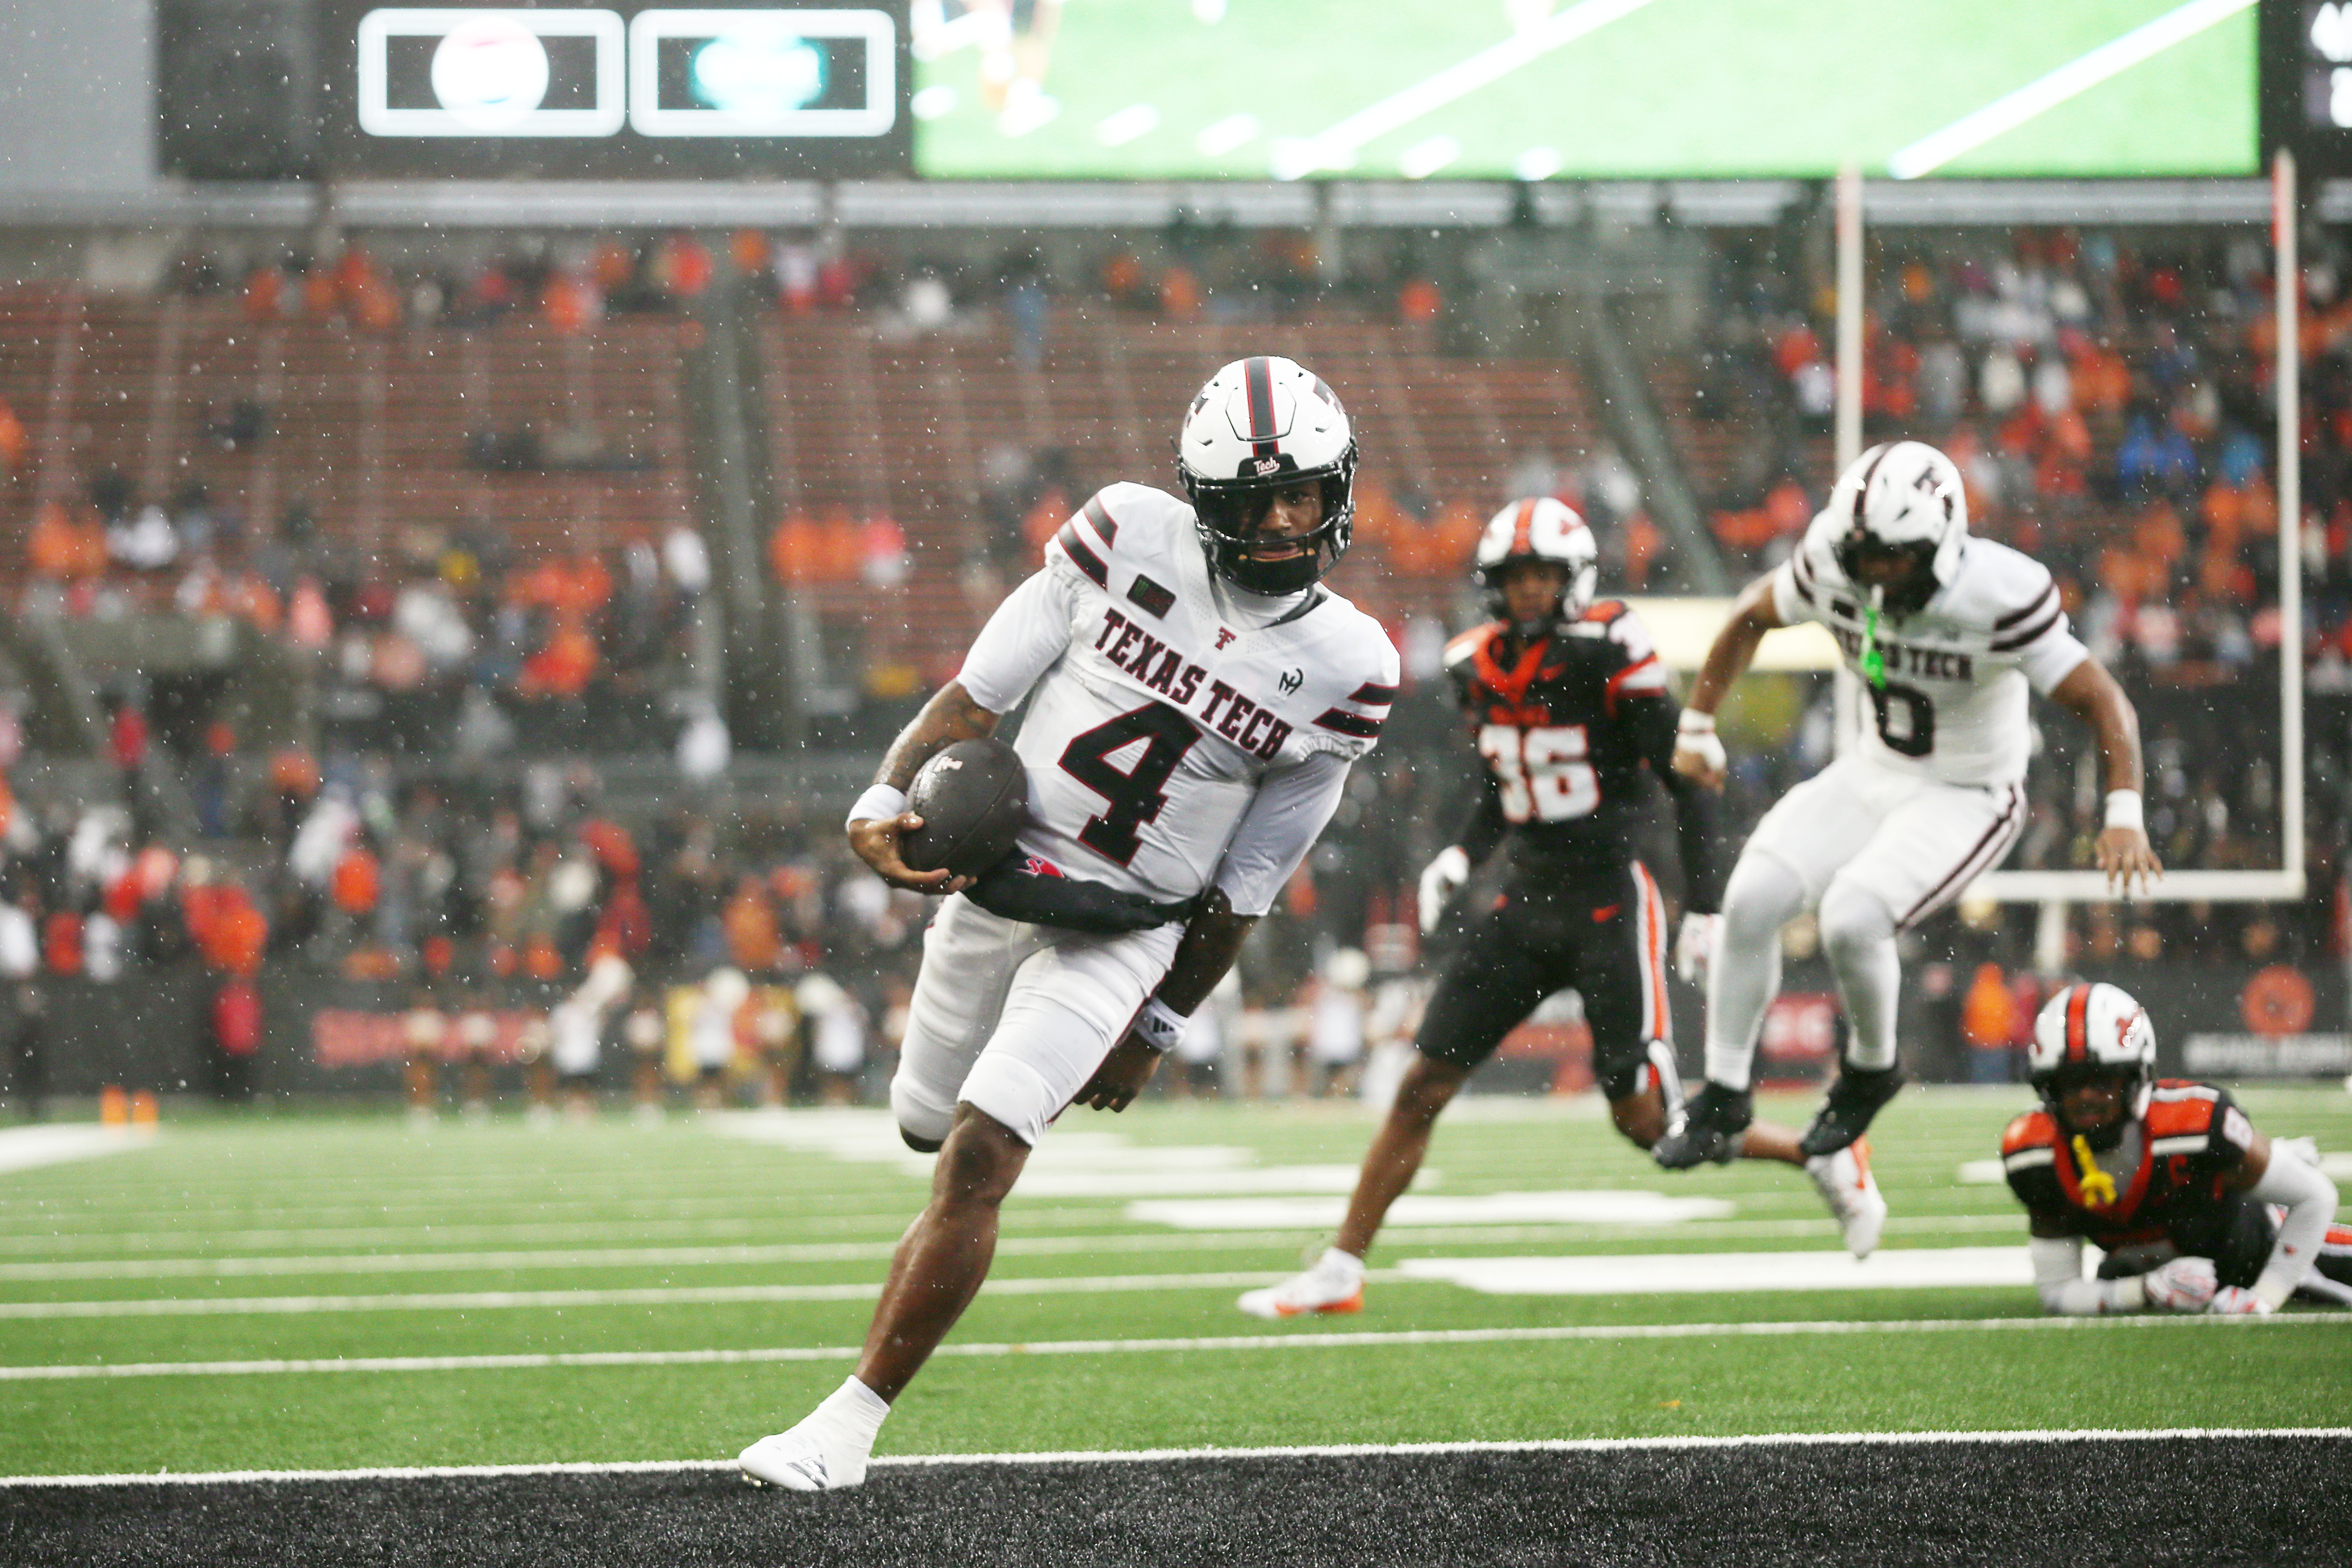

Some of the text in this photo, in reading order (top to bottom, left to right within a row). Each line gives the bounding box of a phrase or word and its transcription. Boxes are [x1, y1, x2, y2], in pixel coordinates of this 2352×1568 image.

[1253, 456, 1280, 476] Tech
[1095, 607, 1293, 761] TEXAS TECH
[1909, 647, 1973, 681] TECH
[1867, 679, 1934, 757] 0
[1058, 700, 1203, 869] 4
